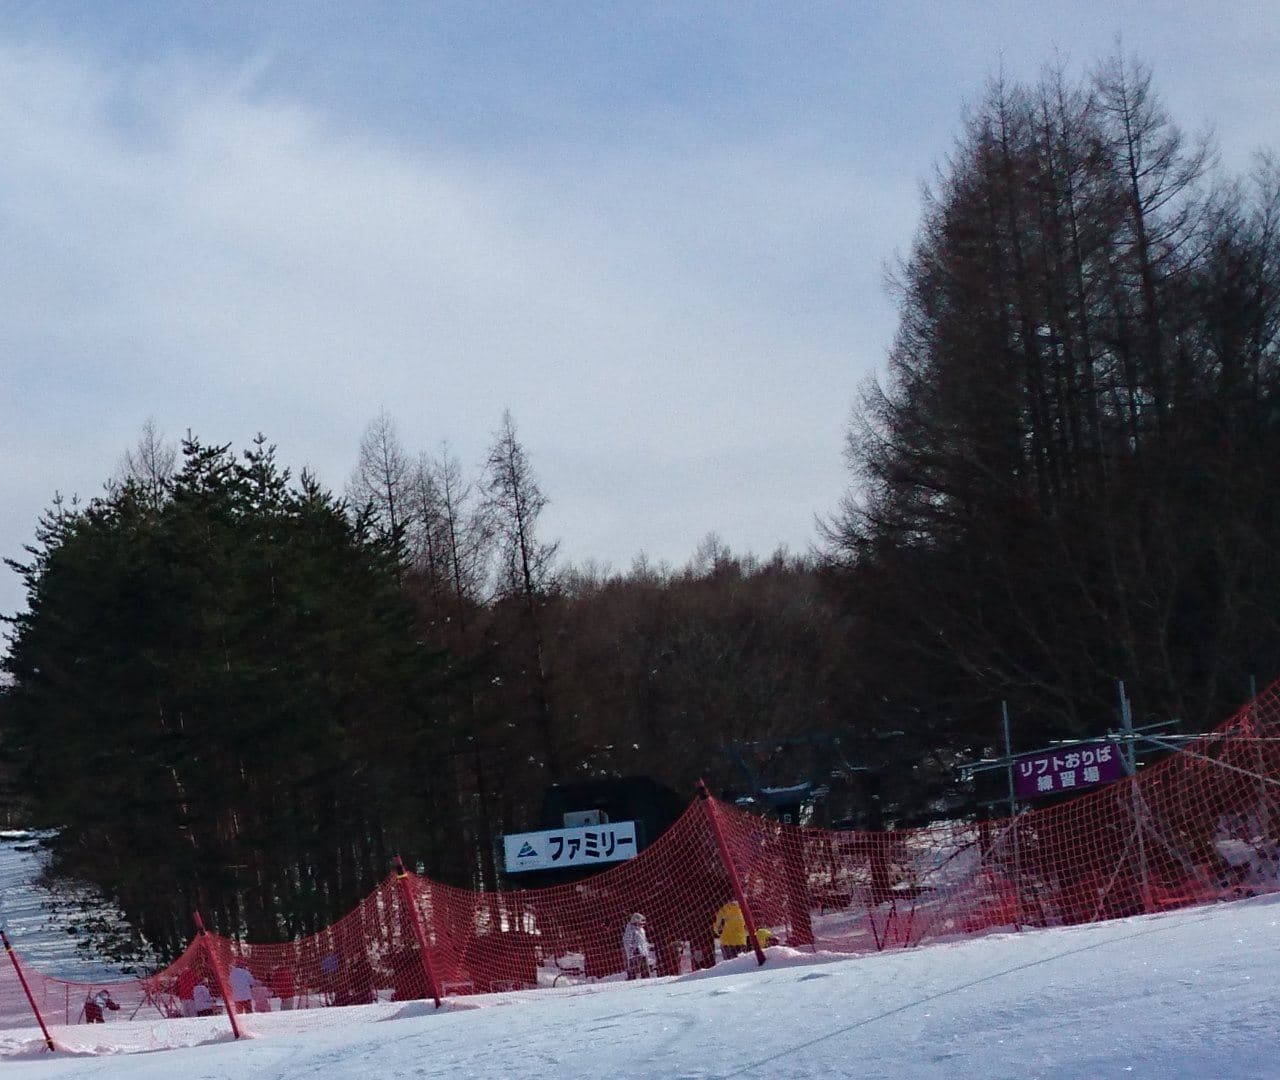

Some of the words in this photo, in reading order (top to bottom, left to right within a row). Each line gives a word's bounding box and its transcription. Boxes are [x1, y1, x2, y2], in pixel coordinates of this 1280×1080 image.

[1020, 745, 1112, 777] リフトおりば
[548, 831, 633, 861] ファミリー
